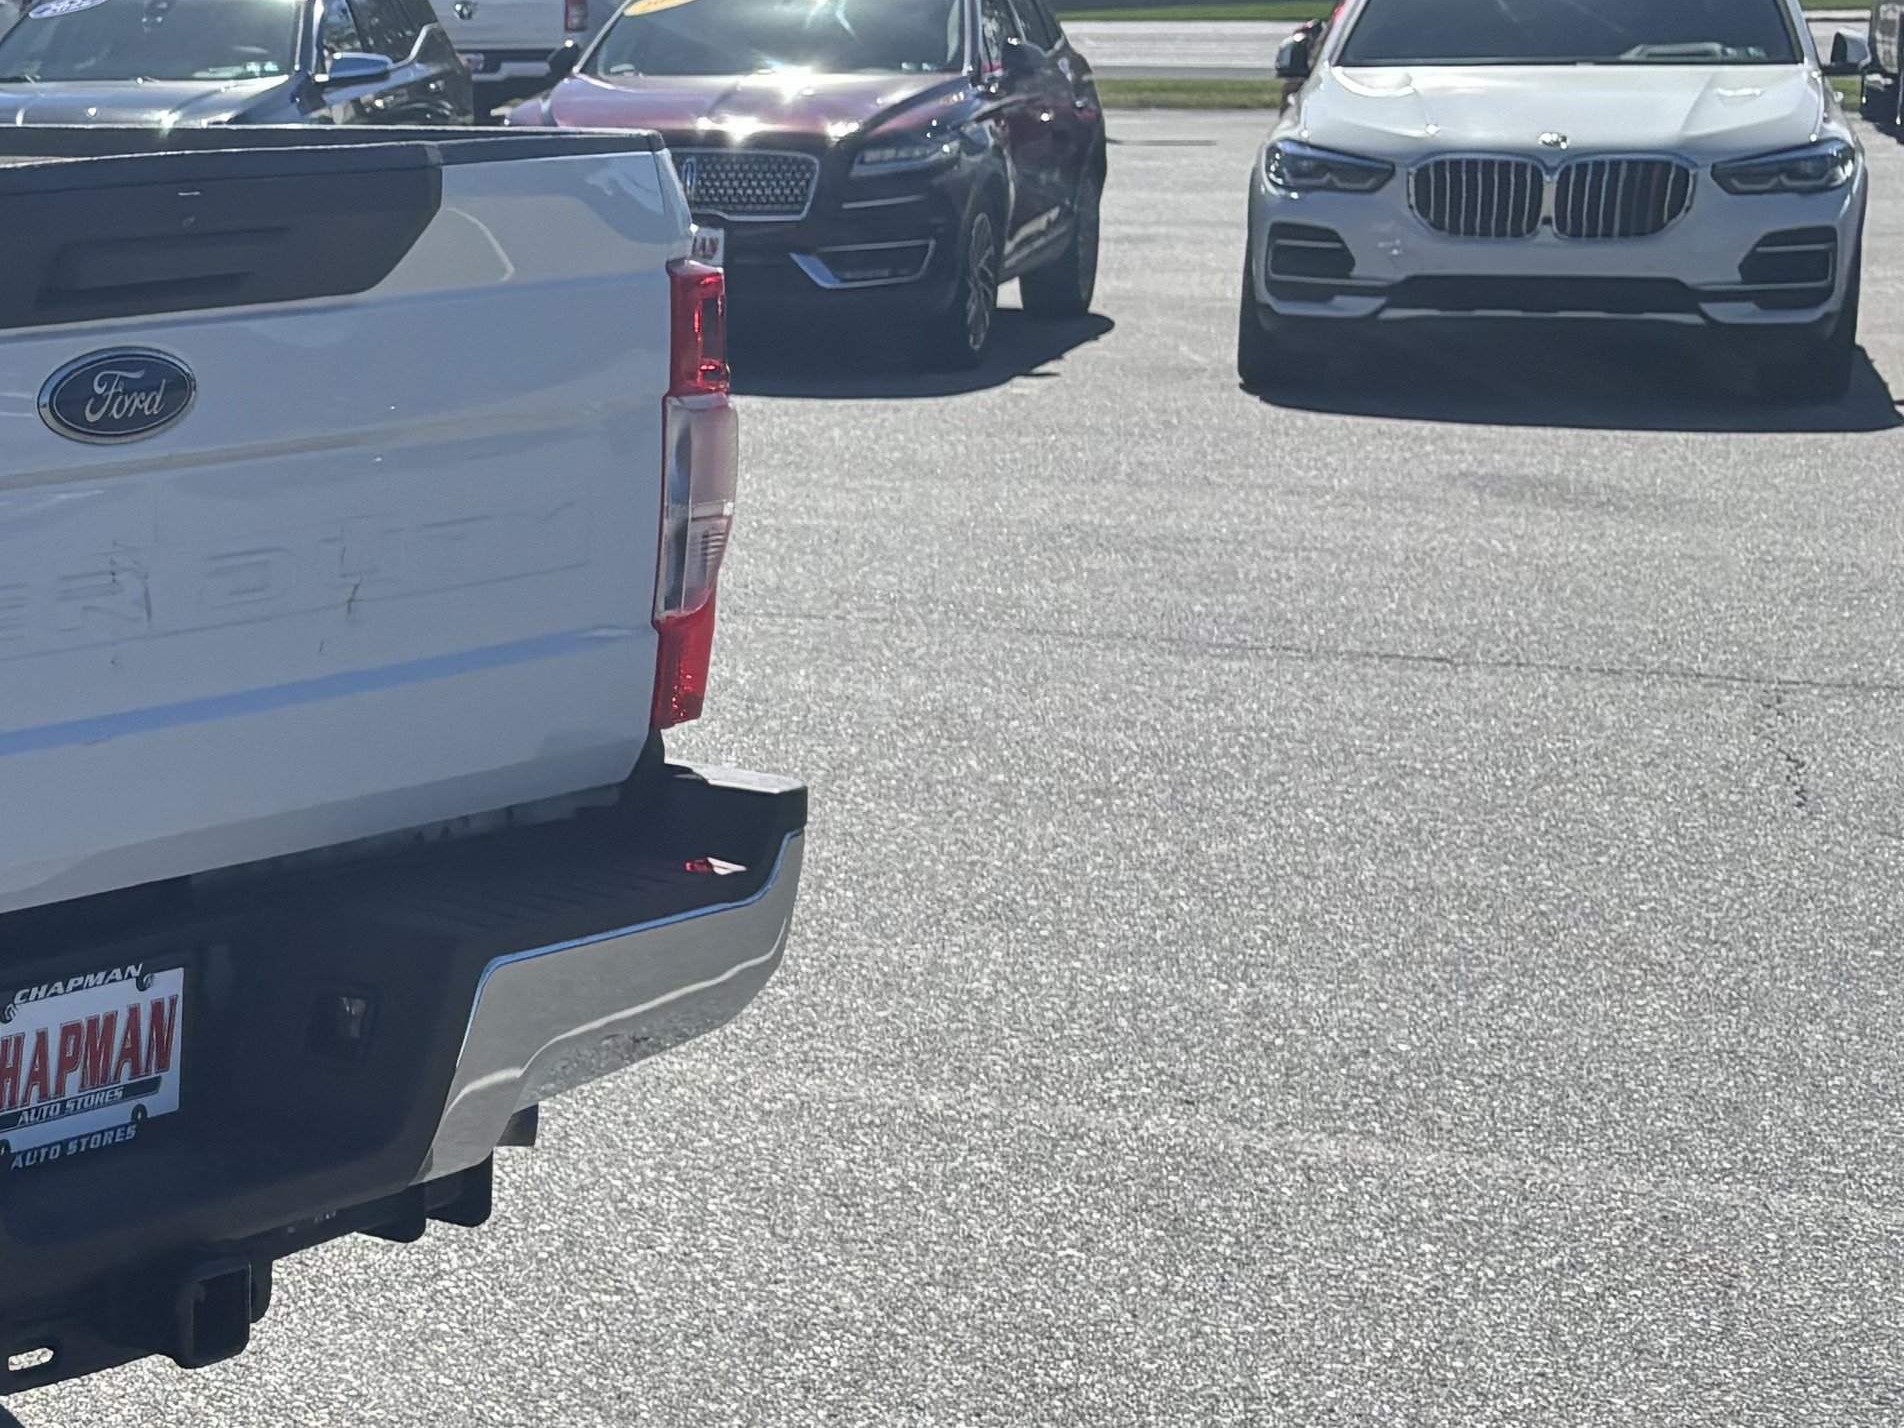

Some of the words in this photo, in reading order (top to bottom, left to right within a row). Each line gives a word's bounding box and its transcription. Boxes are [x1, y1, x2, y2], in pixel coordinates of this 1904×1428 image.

[83, 368, 167, 423] Ford
[14, 963, 143, 1004] CHAPMAN
[17, 1102, 61, 1127] AUTO
[64, 1087, 125, 1113] STORES
[10, 1143, 62, 1172] AUTO
[66, 1124, 138, 1156] STORES
